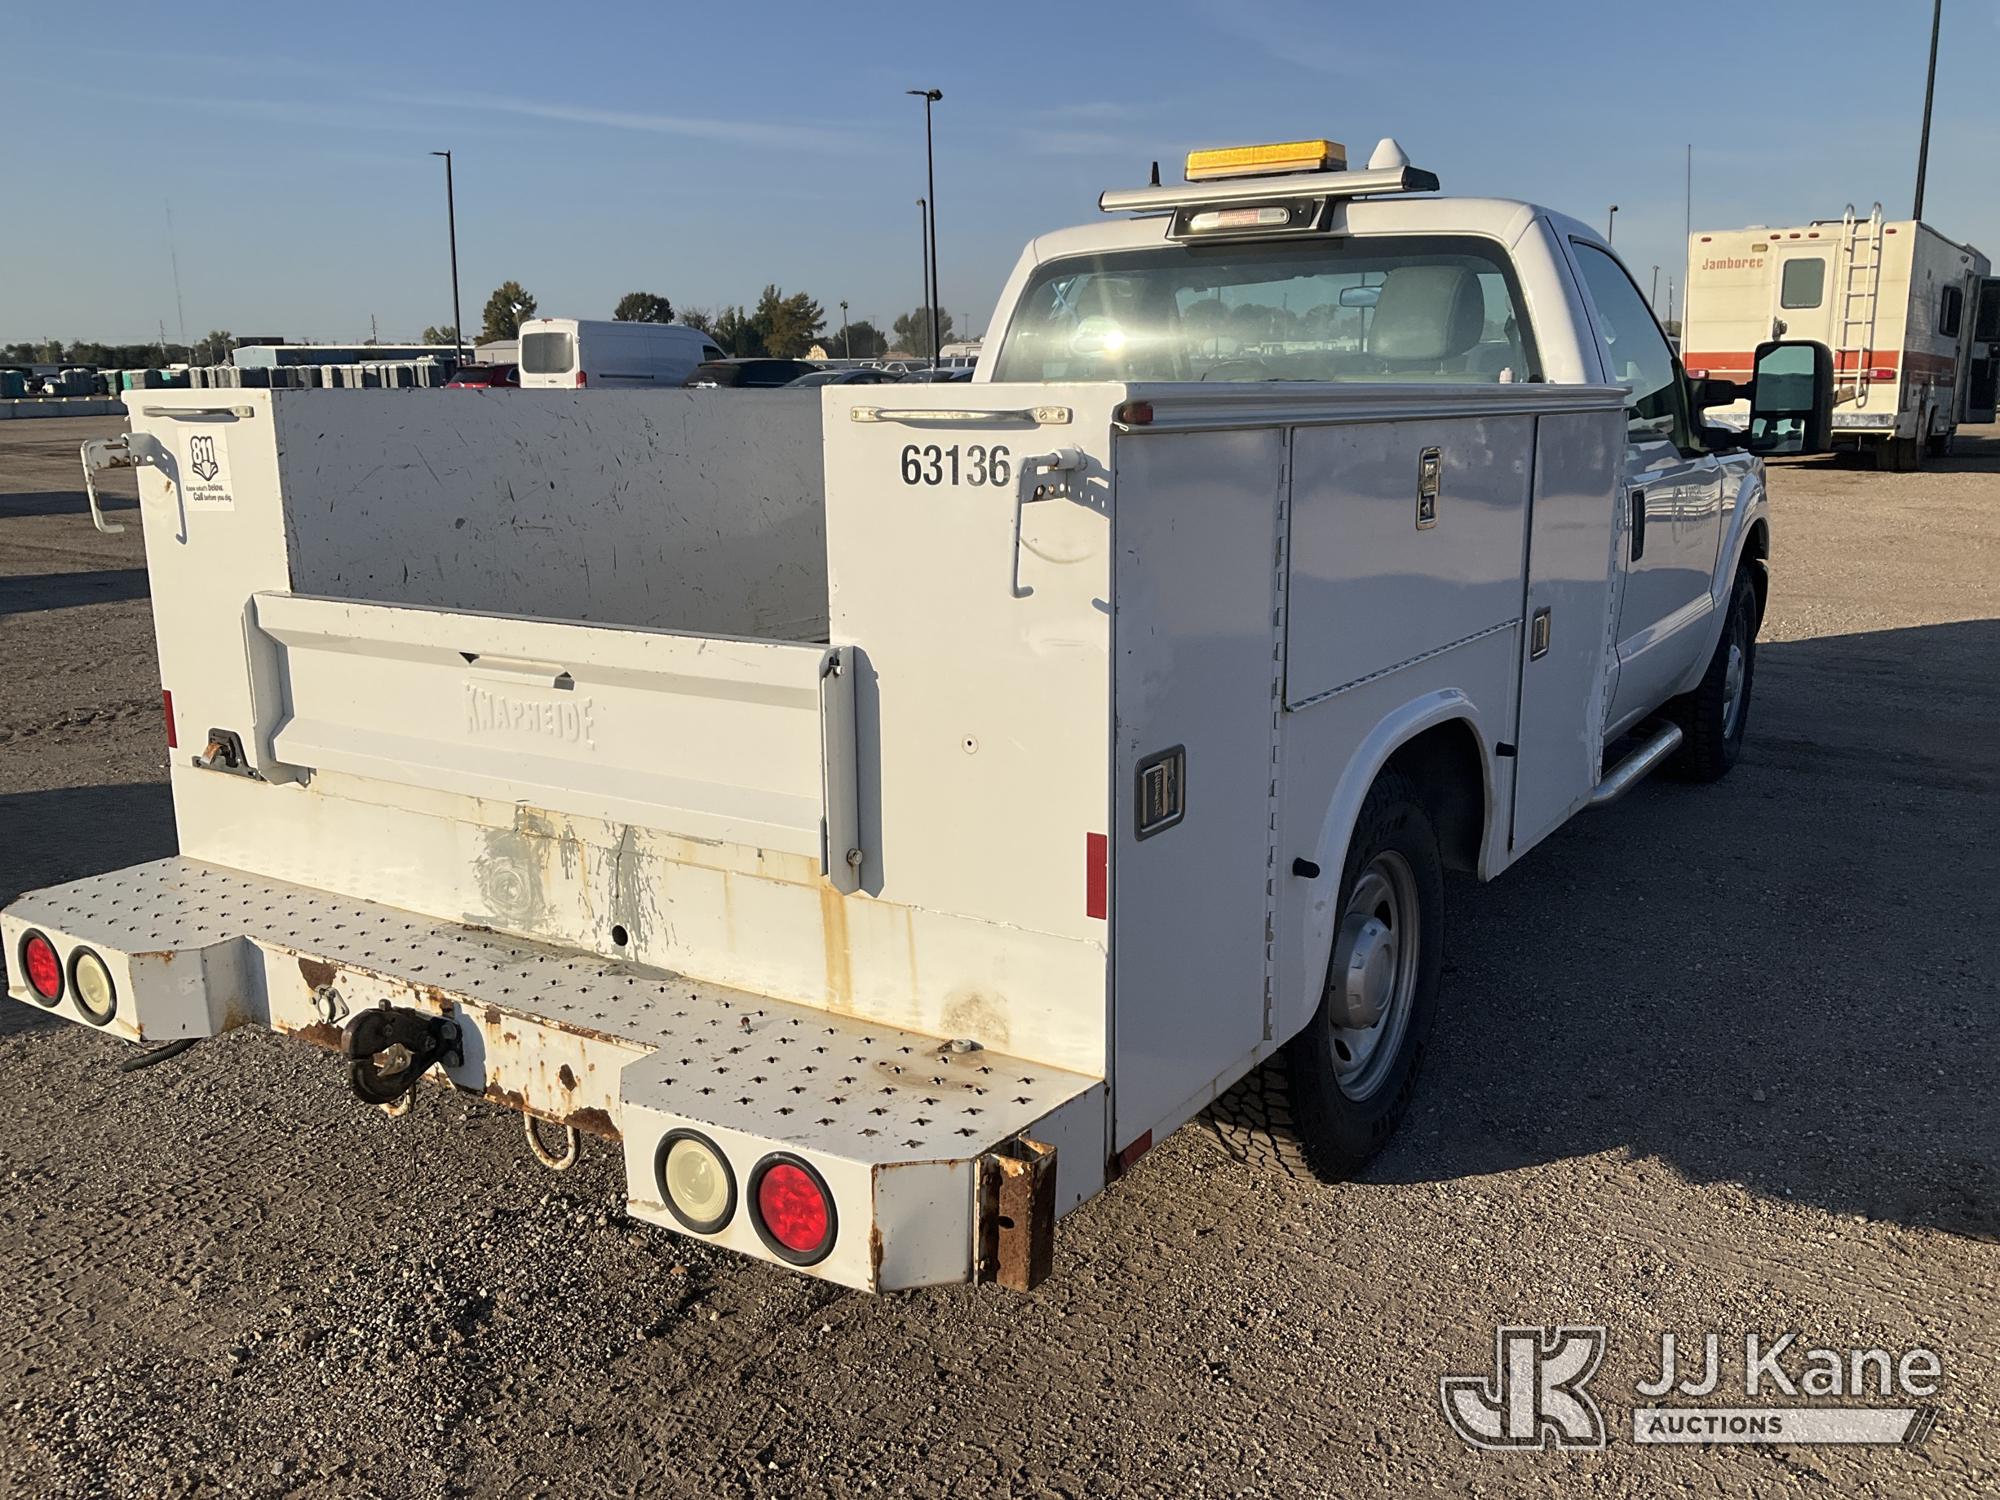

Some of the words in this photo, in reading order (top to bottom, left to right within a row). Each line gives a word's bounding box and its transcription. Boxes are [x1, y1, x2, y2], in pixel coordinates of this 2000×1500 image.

[1702, 257, 1764, 270] Jamboree
[190, 436, 215, 465] 811
[901, 444, 1011, 487] 63136
[193, 492, 203, 501] Call
[463, 682, 596, 749] KNAPHEIDE
